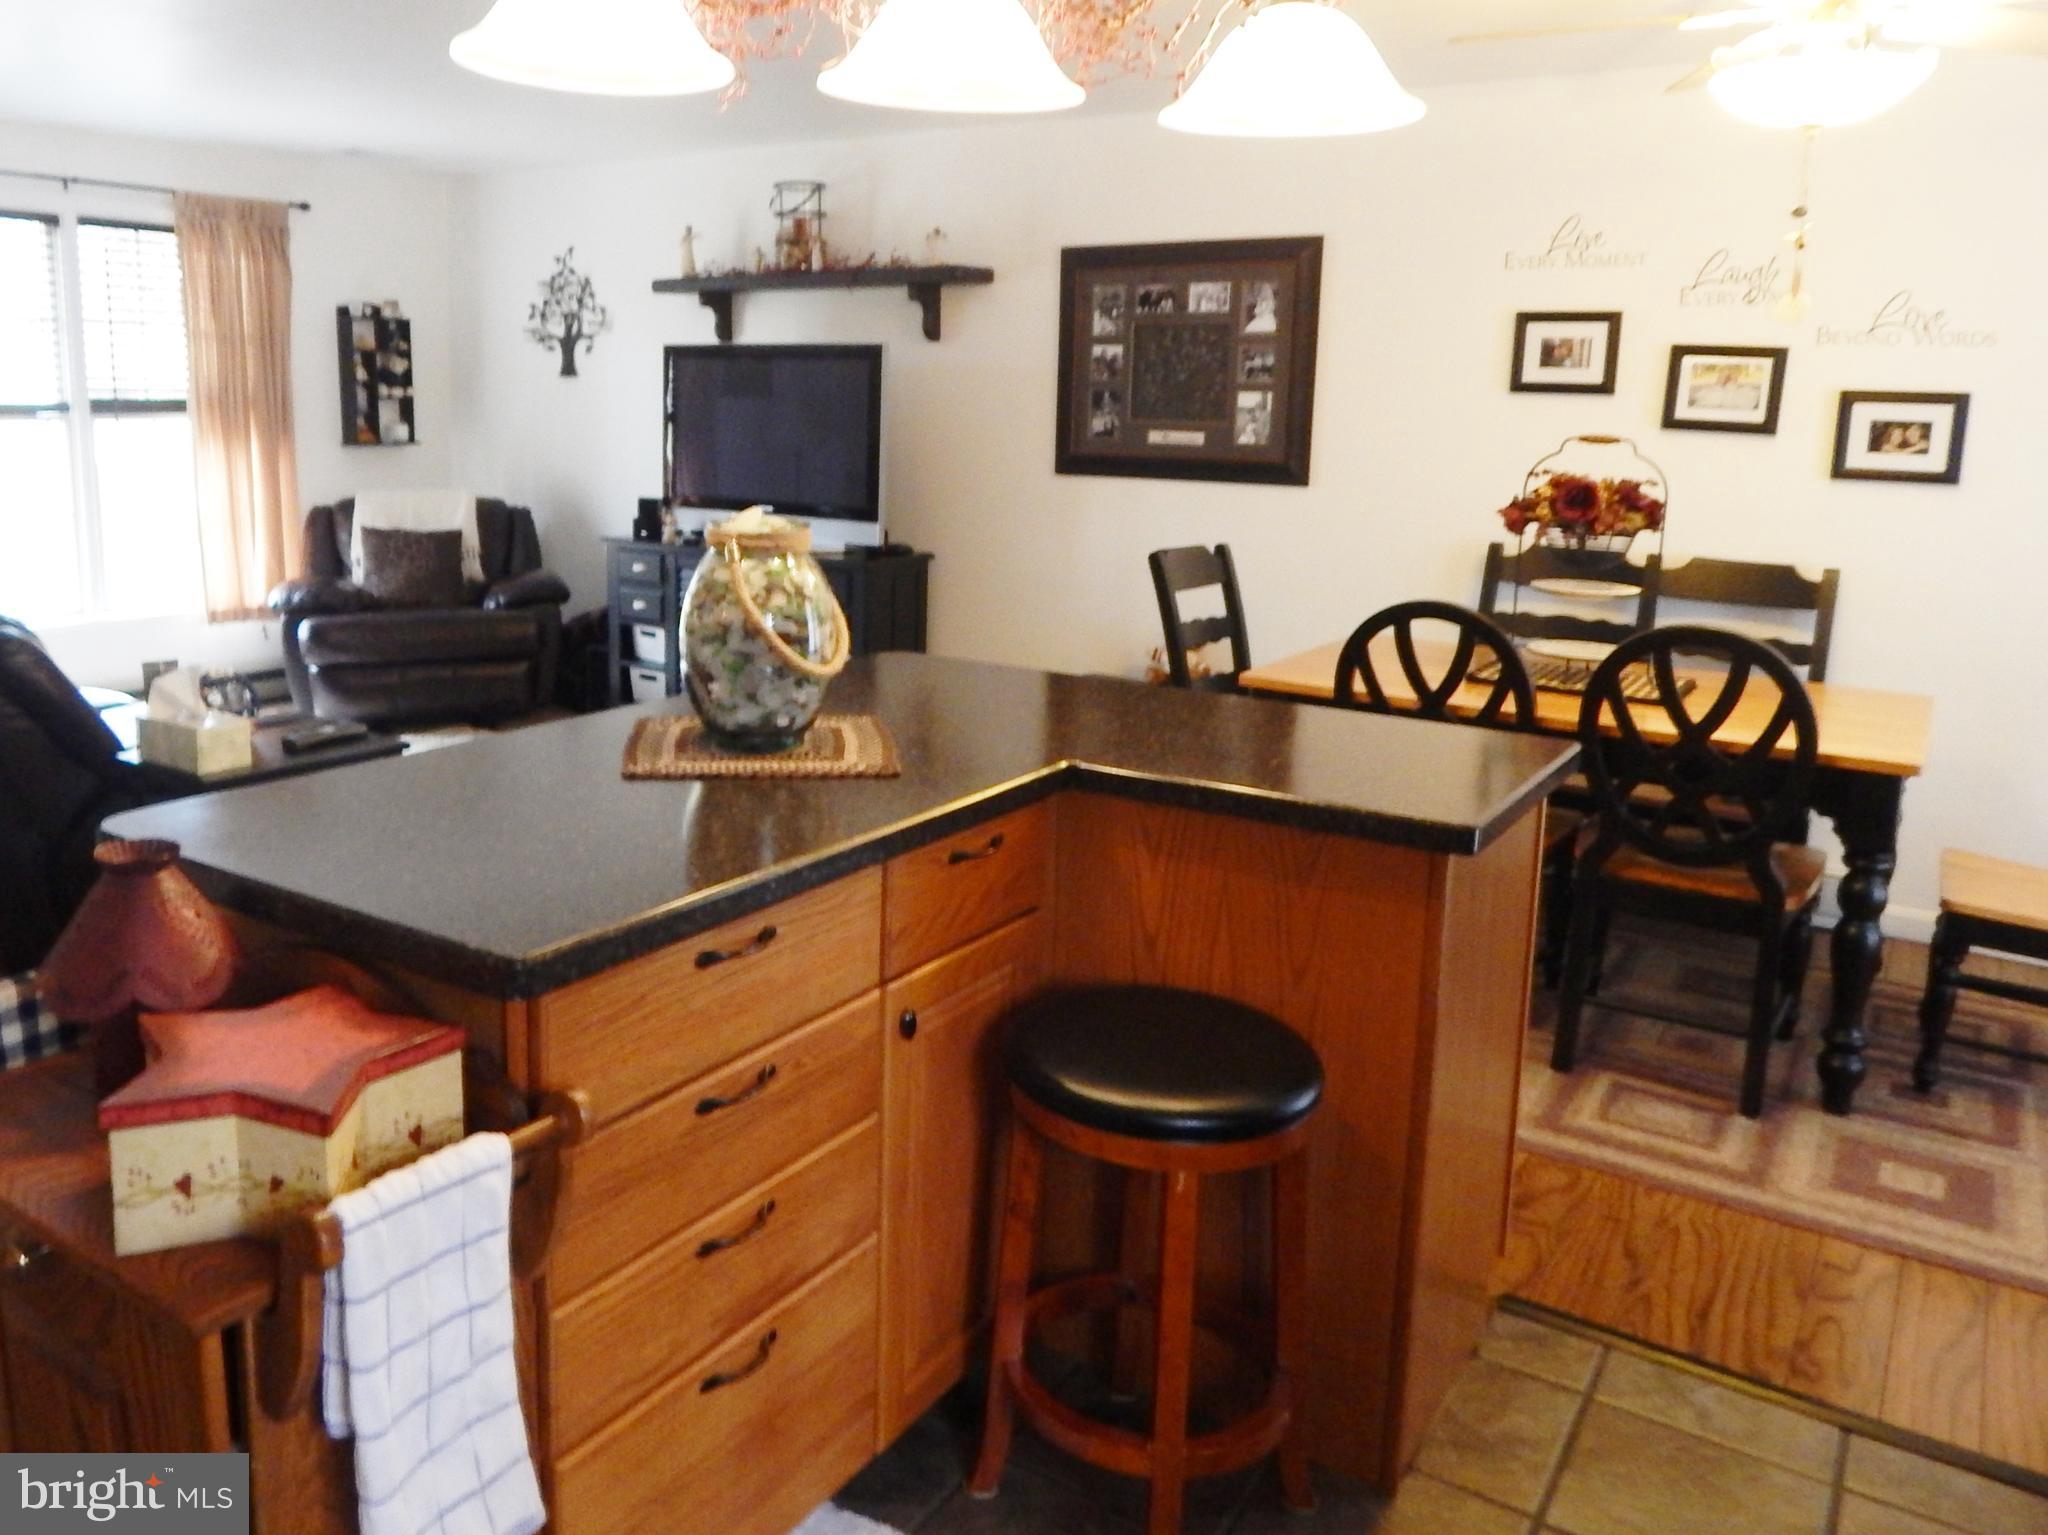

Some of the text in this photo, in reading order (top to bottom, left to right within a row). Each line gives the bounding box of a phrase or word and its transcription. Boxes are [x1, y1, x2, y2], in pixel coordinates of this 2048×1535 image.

[1547, 213, 1608, 255] Live
[1691, 248, 1781, 305] Laugh
[1866, 289, 1951, 335] Love
